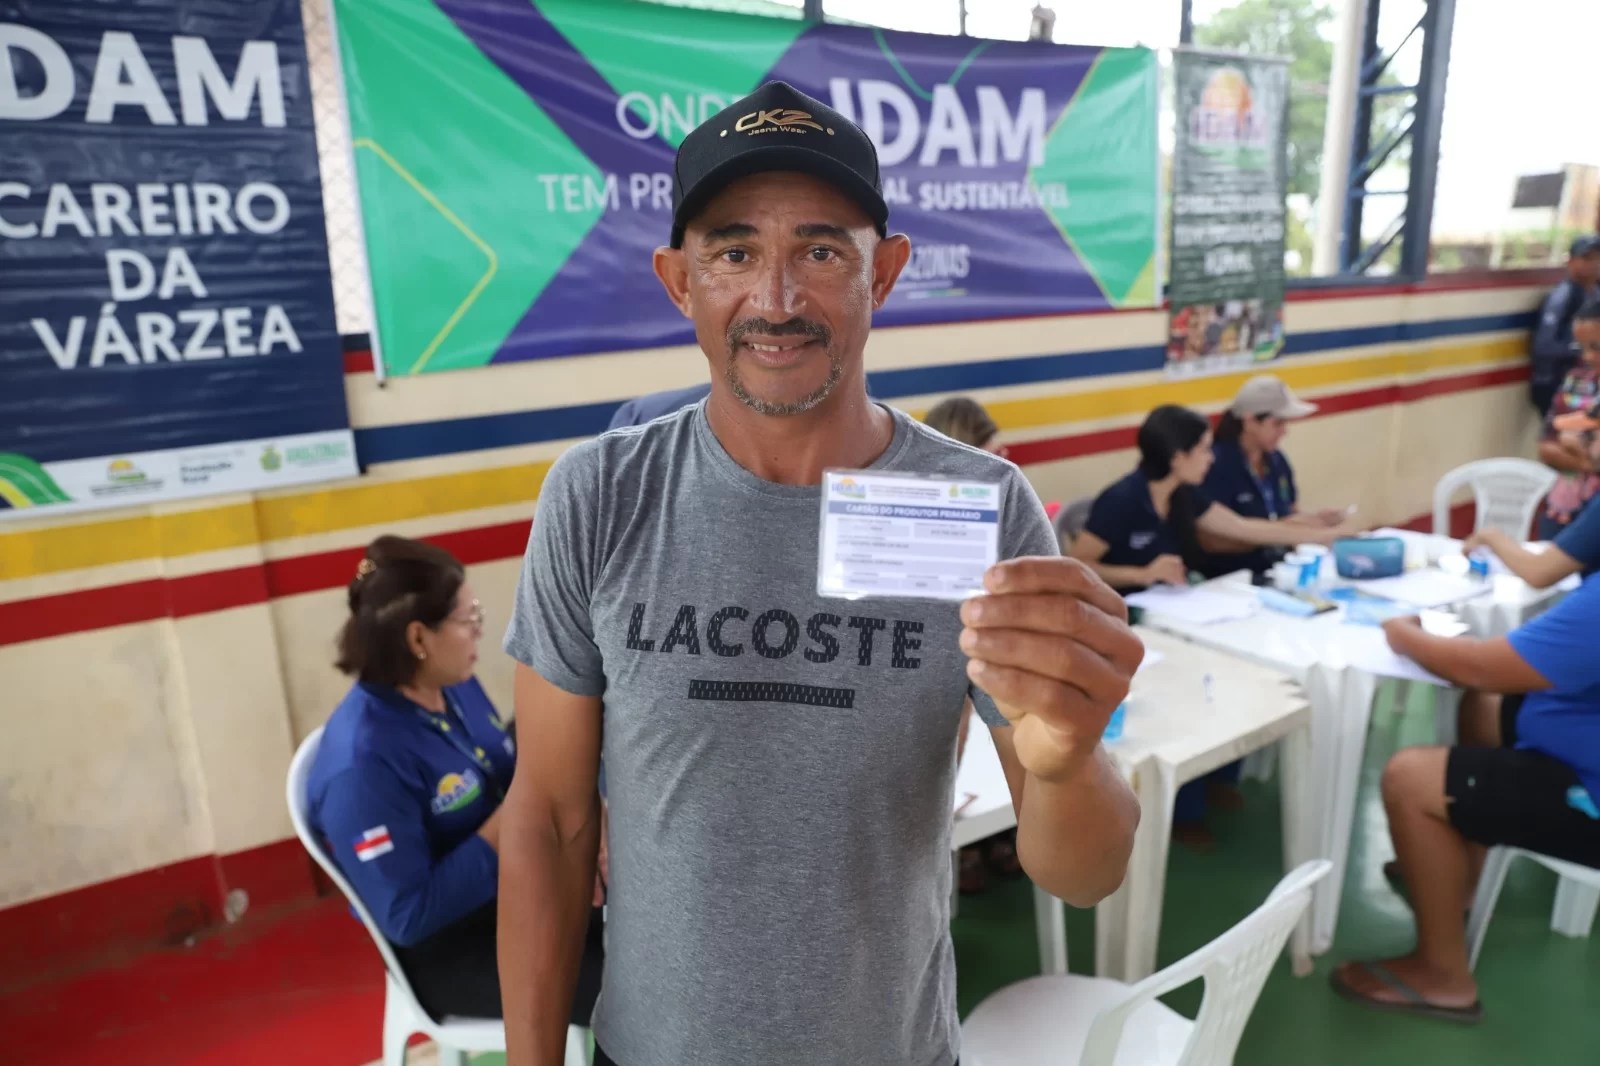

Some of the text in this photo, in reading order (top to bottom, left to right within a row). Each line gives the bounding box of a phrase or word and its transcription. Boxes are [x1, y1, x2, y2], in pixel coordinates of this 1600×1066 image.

[615, 91, 748, 139] OND
[748, 125, 807, 136] Jeans Wear
[0, 181, 291, 240] CAREIRO
[536, 173, 621, 212] TEM
[106, 247, 208, 302] DA
[31, 302, 303, 370] VÁRZEA
[845, 503, 982, 521] CARTÃO DO PRODUTOR PRIMÁRIO
[625, 602, 925, 669] LACOSTE
